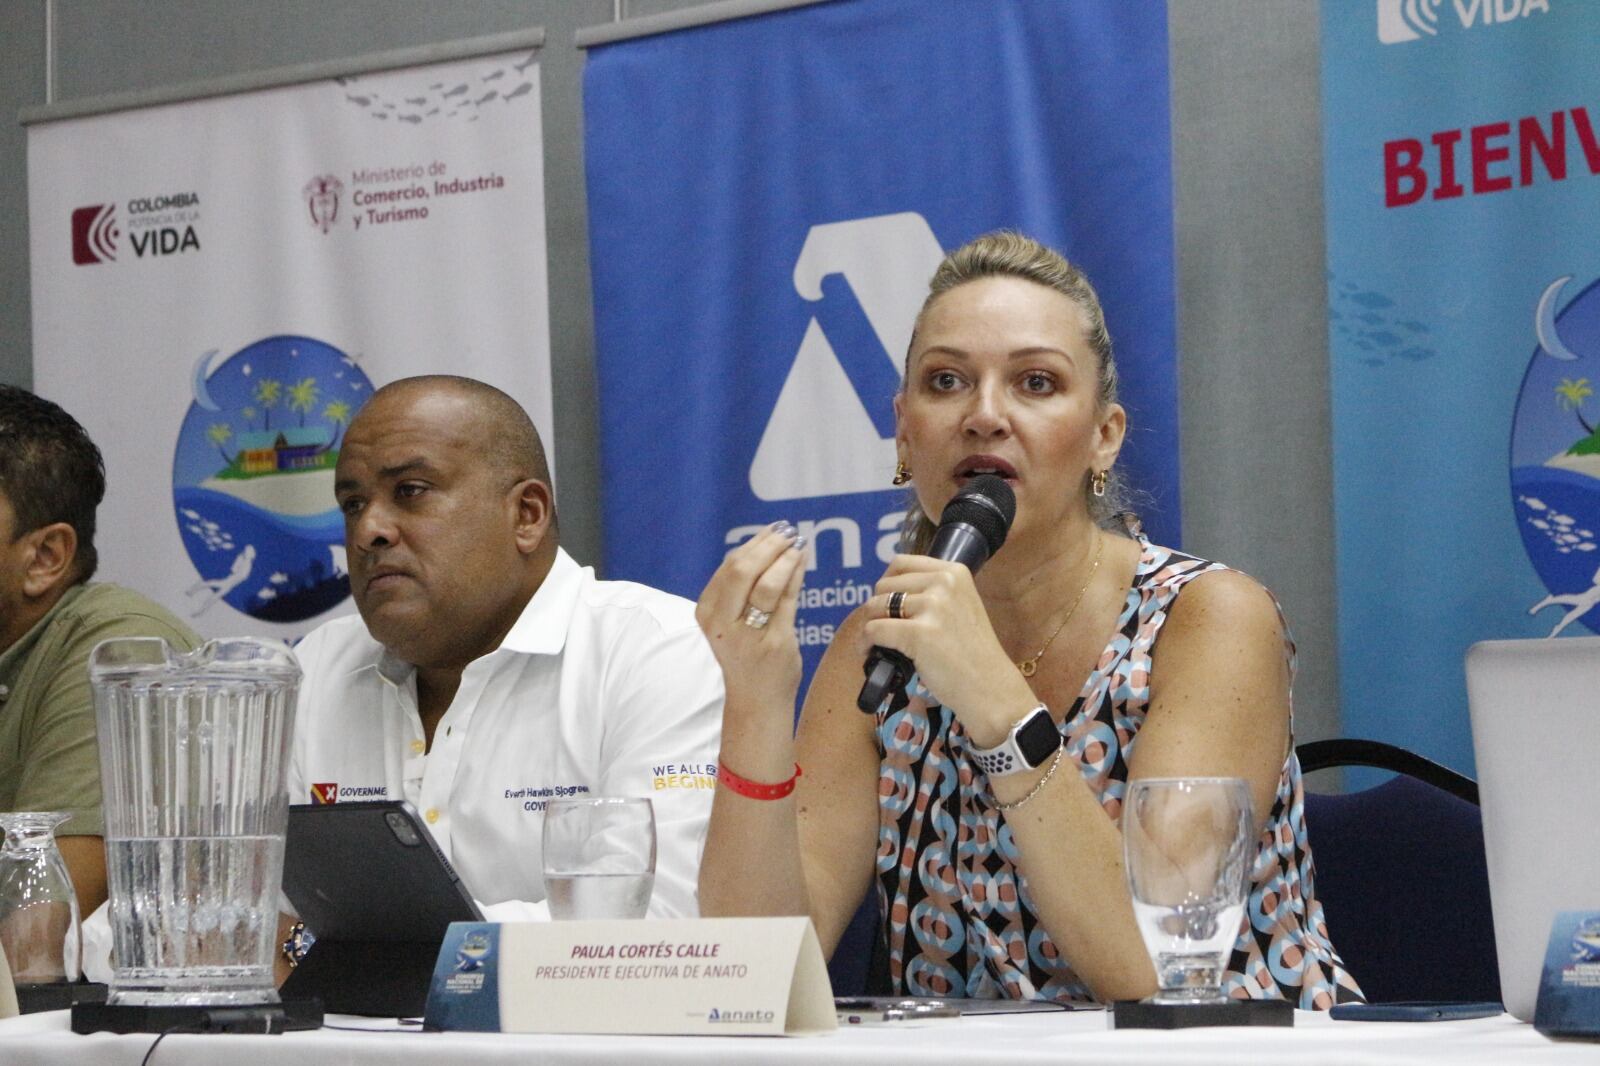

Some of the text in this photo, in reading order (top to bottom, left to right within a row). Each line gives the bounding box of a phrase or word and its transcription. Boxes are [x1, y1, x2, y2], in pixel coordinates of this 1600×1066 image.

[352, 160, 447, 185] Ministerio de
[353, 172, 505, 207] Comercio, Industria
[128, 192, 199, 214] COLOMBIA
[352, 204, 429, 230] y Turismo
[129, 225, 200, 258] VIDA
[797, 579, 872, 609] iación
[653, 765, 677, 776] WE
[680, 764, 704, 775] ALL
[571, 940, 720, 959] PAULA CORTÉS CALLE
[535, 964, 748, 980] PRESIDENTE EJECUTIVA DE ANATO
[722, 1010, 775, 1020] anato
